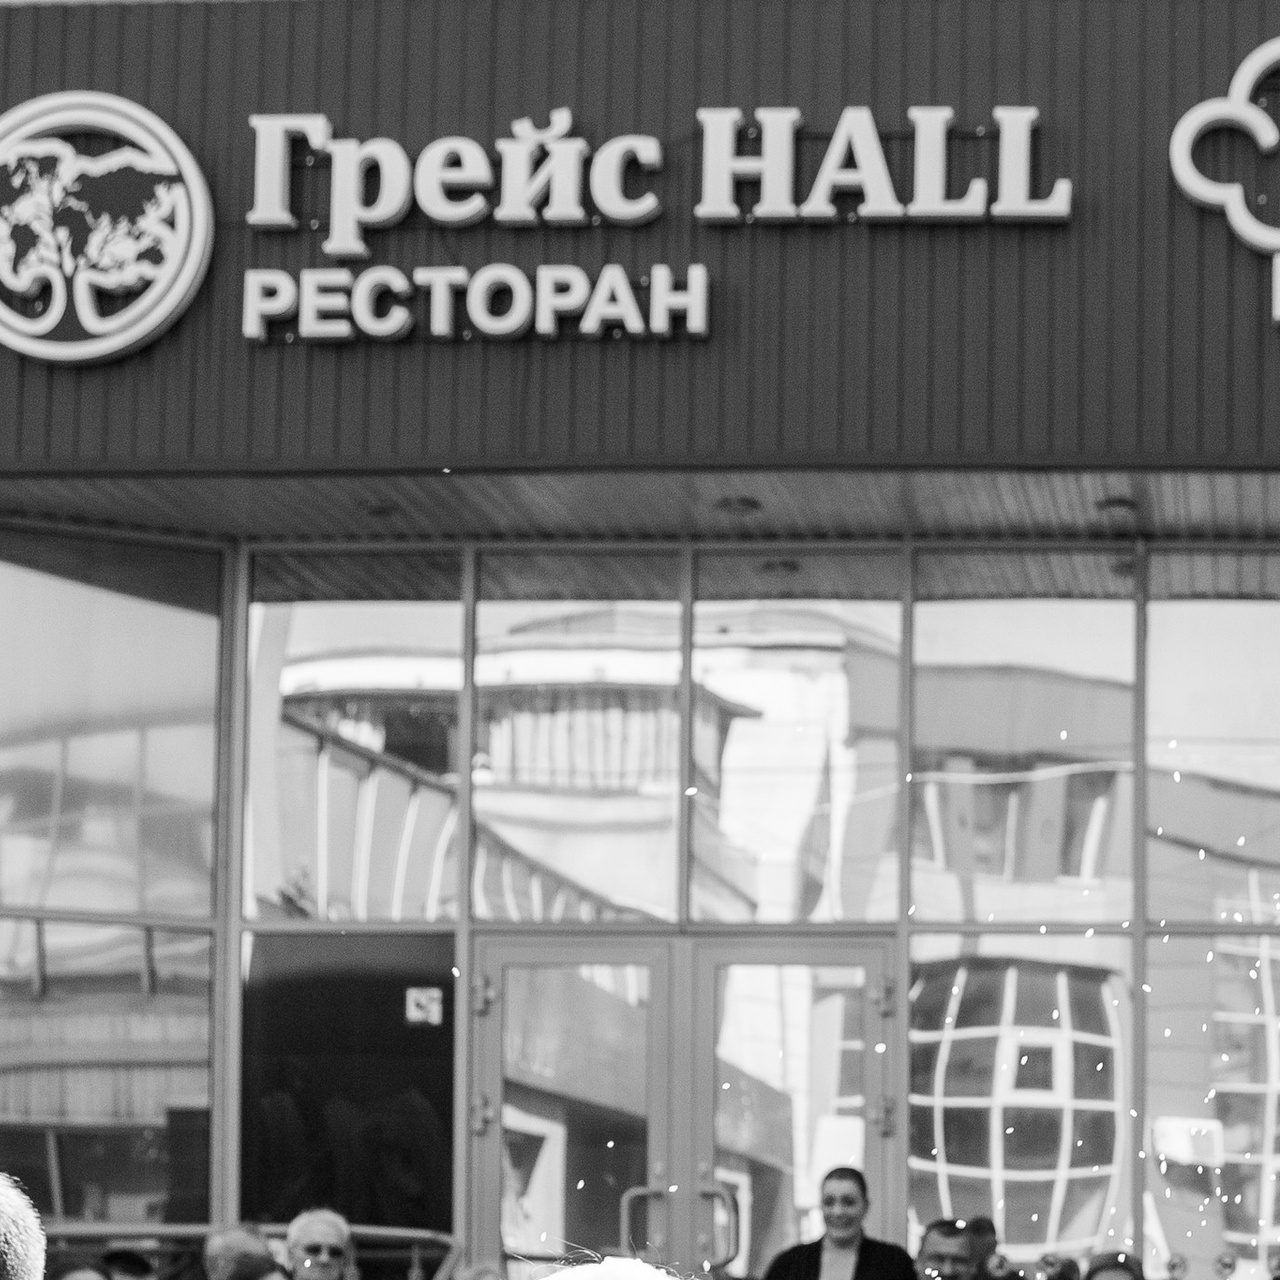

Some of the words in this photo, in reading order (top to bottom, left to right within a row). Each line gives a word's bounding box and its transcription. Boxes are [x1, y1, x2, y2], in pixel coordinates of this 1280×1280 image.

[245, 106, 663, 257] Грейс
[694, 105, 1074, 219] HALL
[242, 263, 709, 339] РЕСТОРАН
